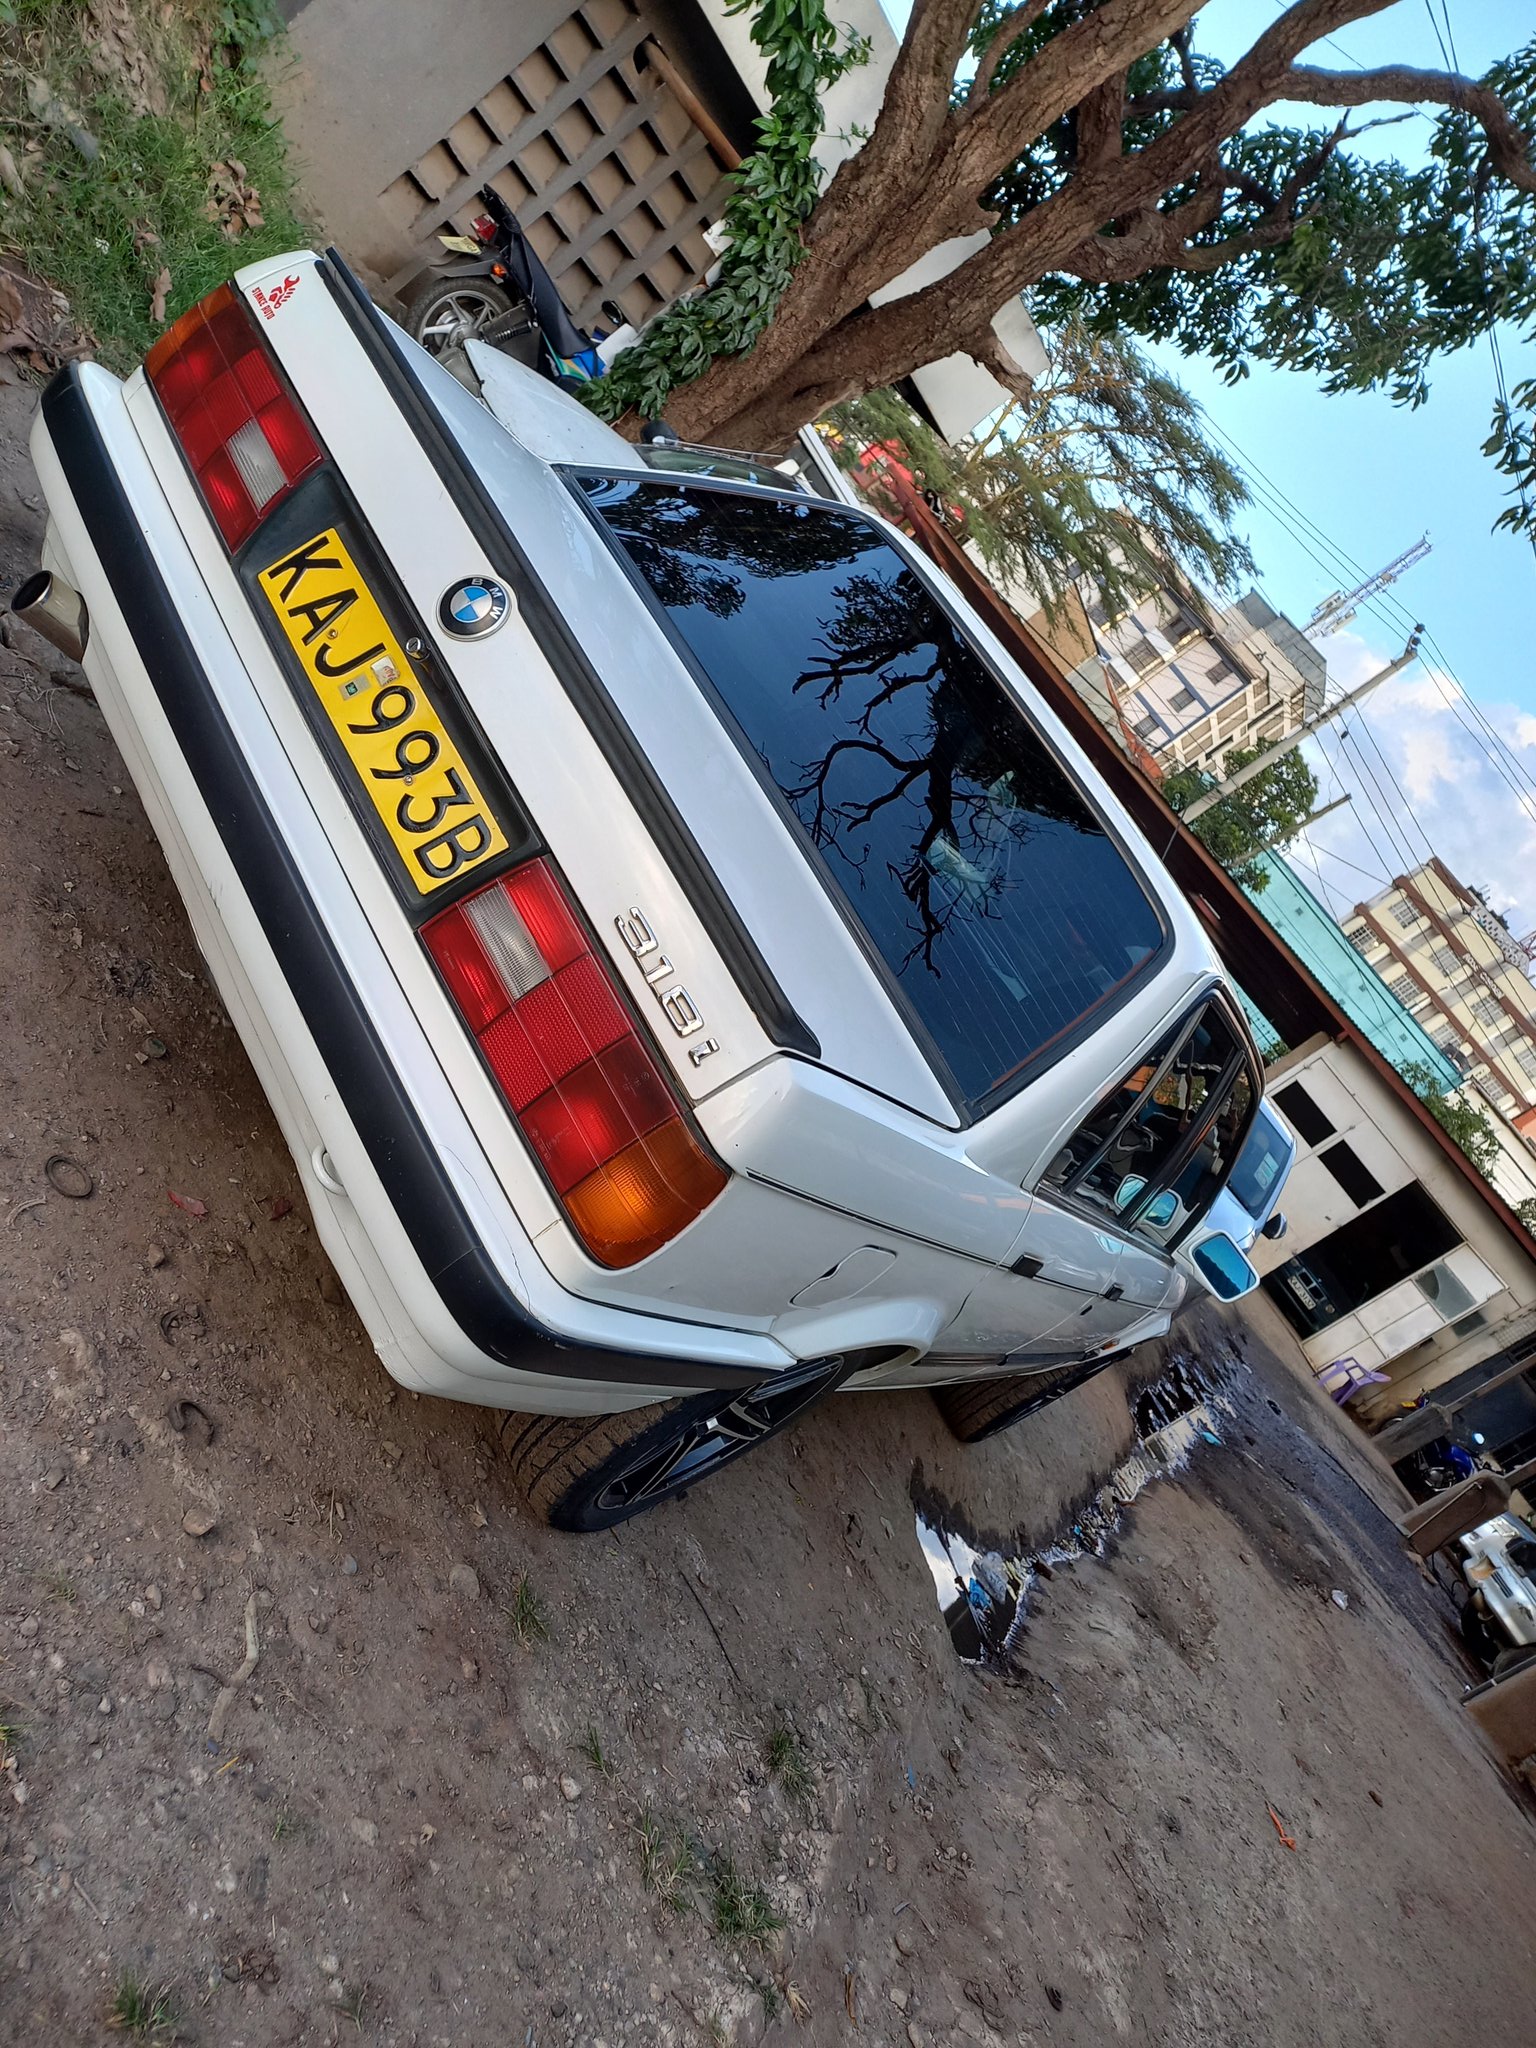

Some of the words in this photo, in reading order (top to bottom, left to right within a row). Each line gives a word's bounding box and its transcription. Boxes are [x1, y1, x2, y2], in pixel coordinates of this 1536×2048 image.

[261, 304, 275, 320] AUTO
[471, 578, 504, 621] BMW
[268, 535, 386, 678] KAJ
[346, 684, 492, 878] 993B
[614, 906, 720, 1068] 318i
